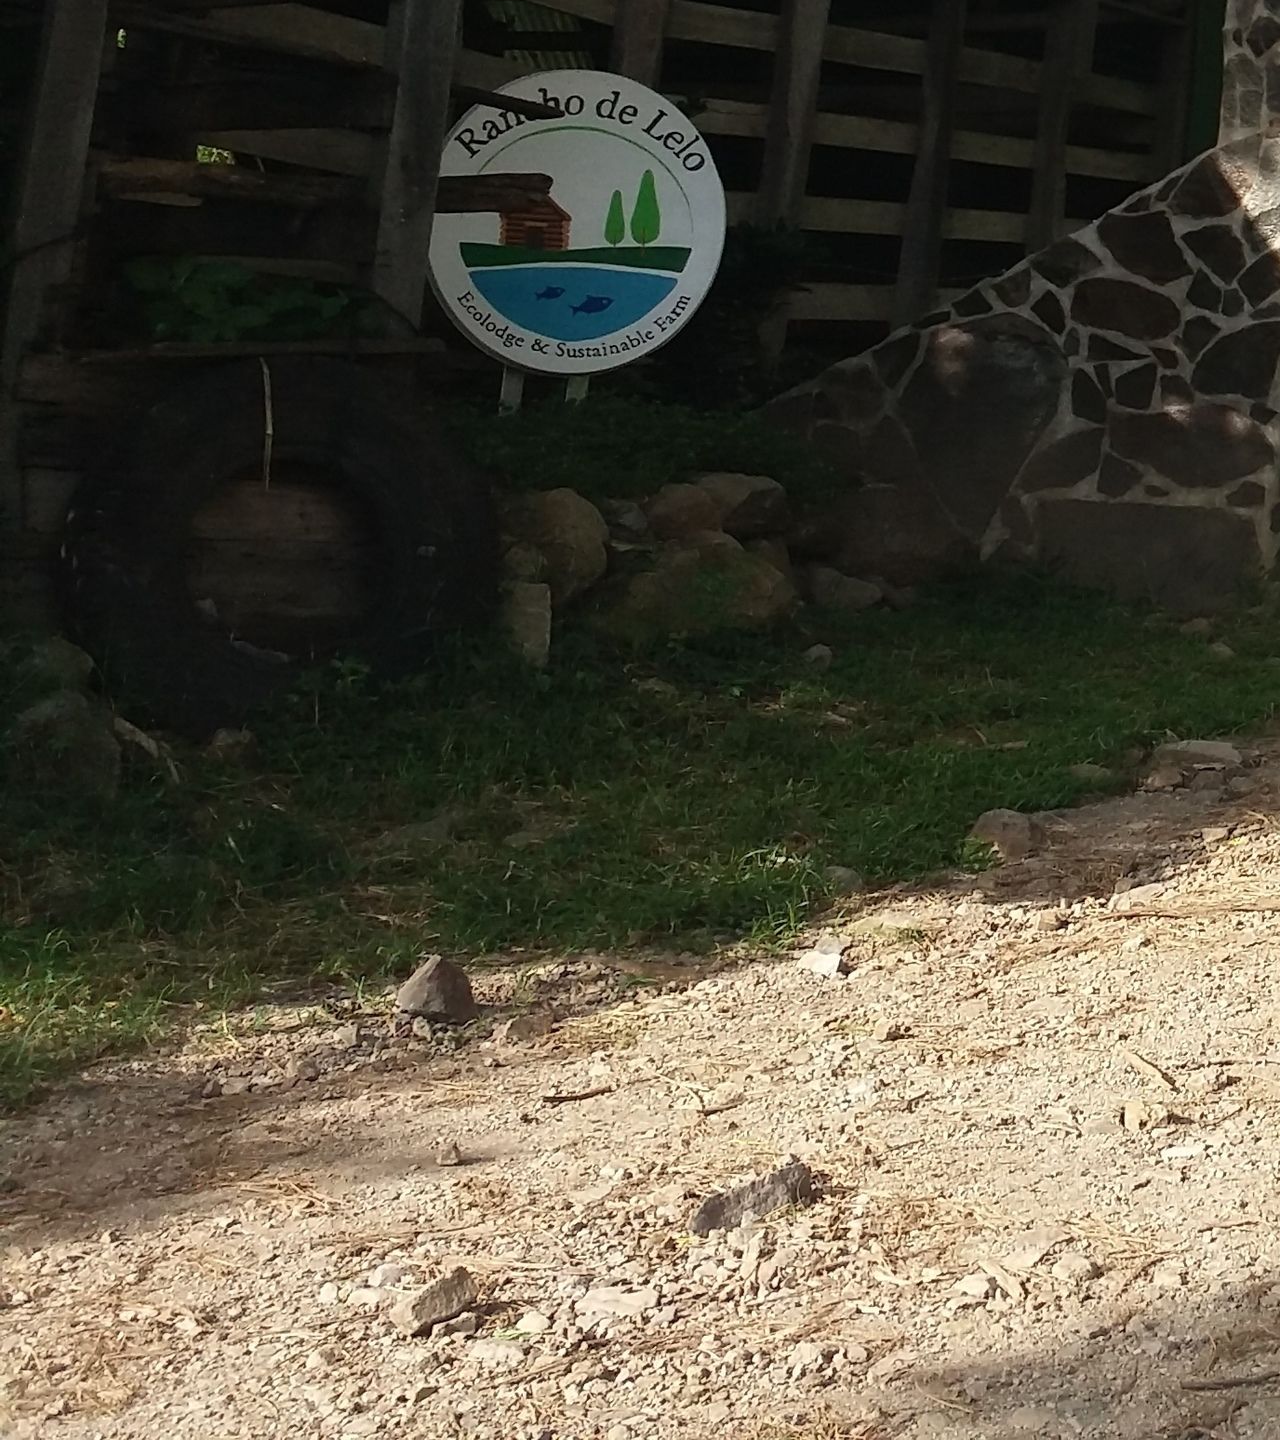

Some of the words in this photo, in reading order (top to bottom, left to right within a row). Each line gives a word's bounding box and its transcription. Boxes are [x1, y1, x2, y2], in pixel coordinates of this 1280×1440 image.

[454, 88, 585, 159] Ranho
[596, 91, 639, 125] de
[642, 109, 706, 173] Lelo
[456, 291, 525, 348] Ecolodge
[530, 338, 550, 356] &
[555, 330, 656, 359] Sustainable
[653, 293, 691, 333] Farm
